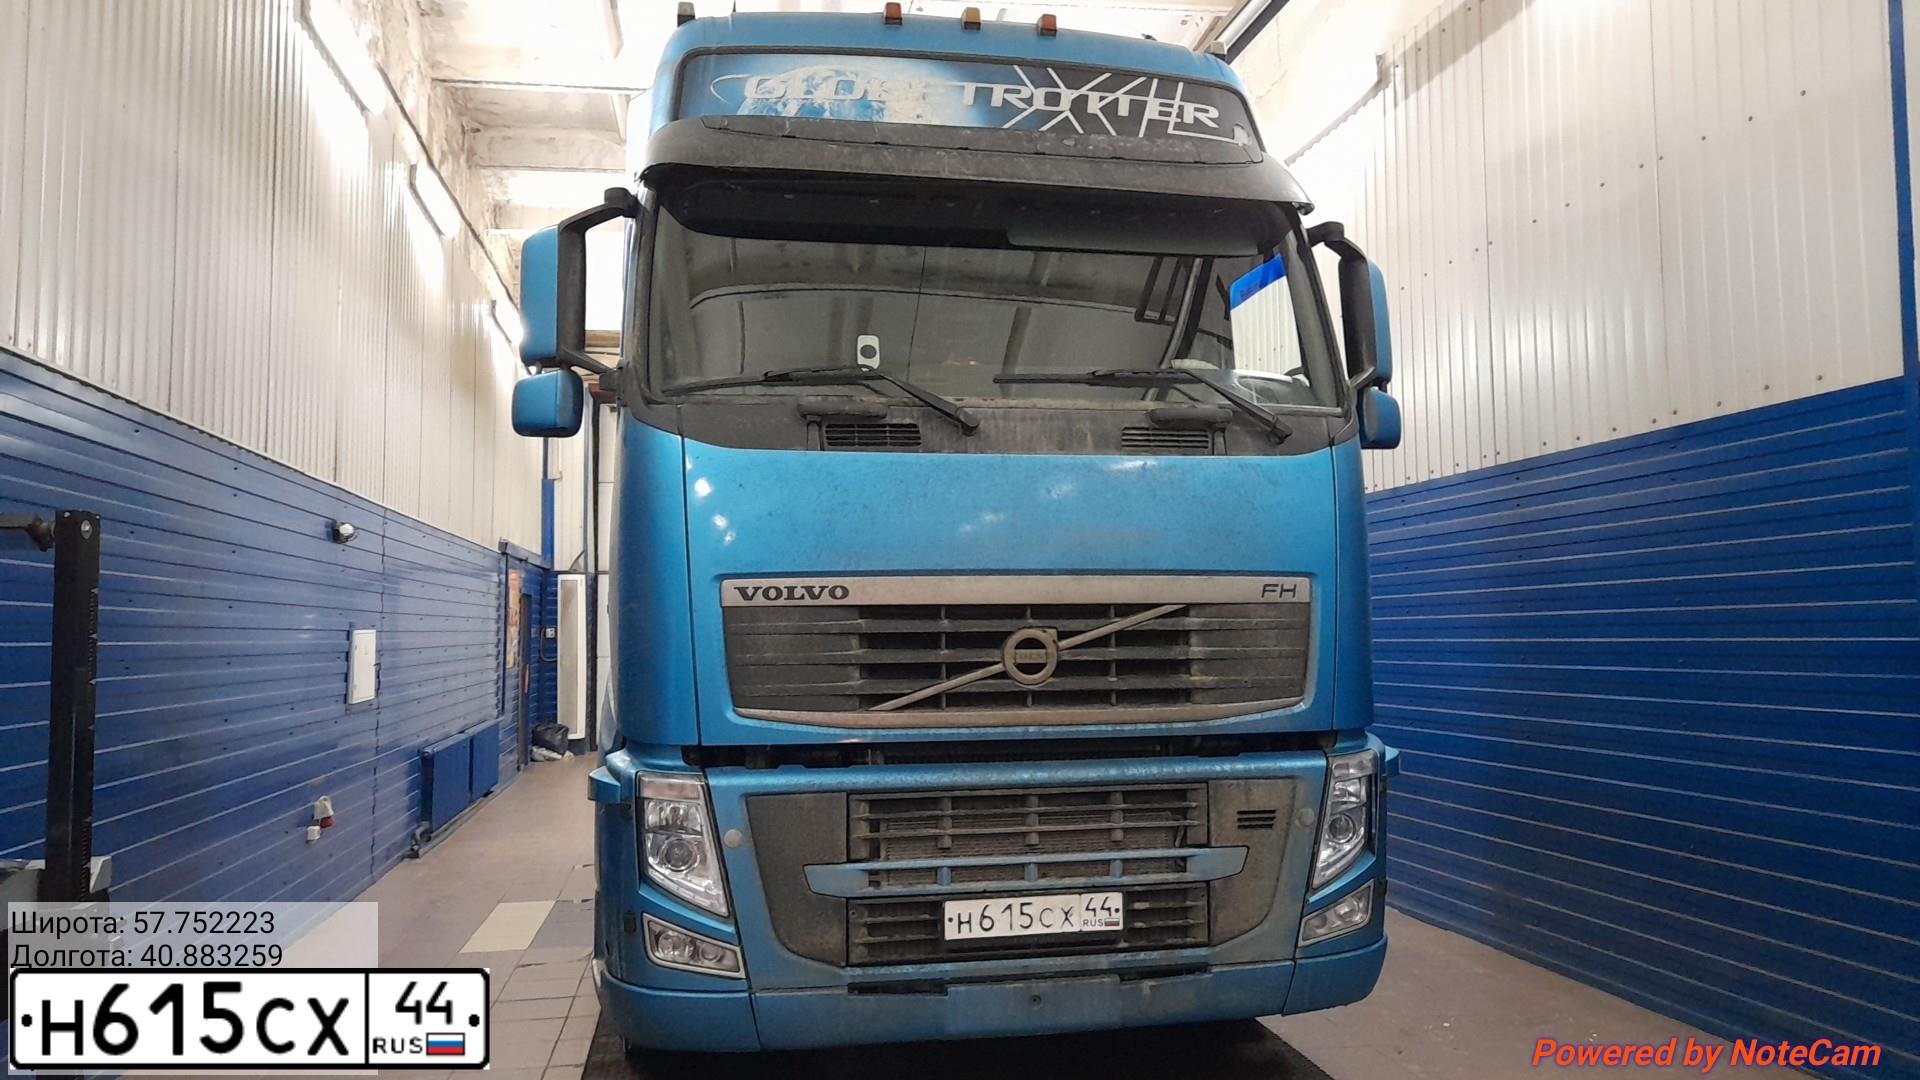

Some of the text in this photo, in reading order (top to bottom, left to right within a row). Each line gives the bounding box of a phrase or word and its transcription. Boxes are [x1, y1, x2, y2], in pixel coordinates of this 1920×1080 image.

[734, 585, 850, 601] VOLVO
[1261, 583, 1297, 599] FH
[1084, 896, 1113, 918] 44
[1082, 918, 1104, 928] RUS
